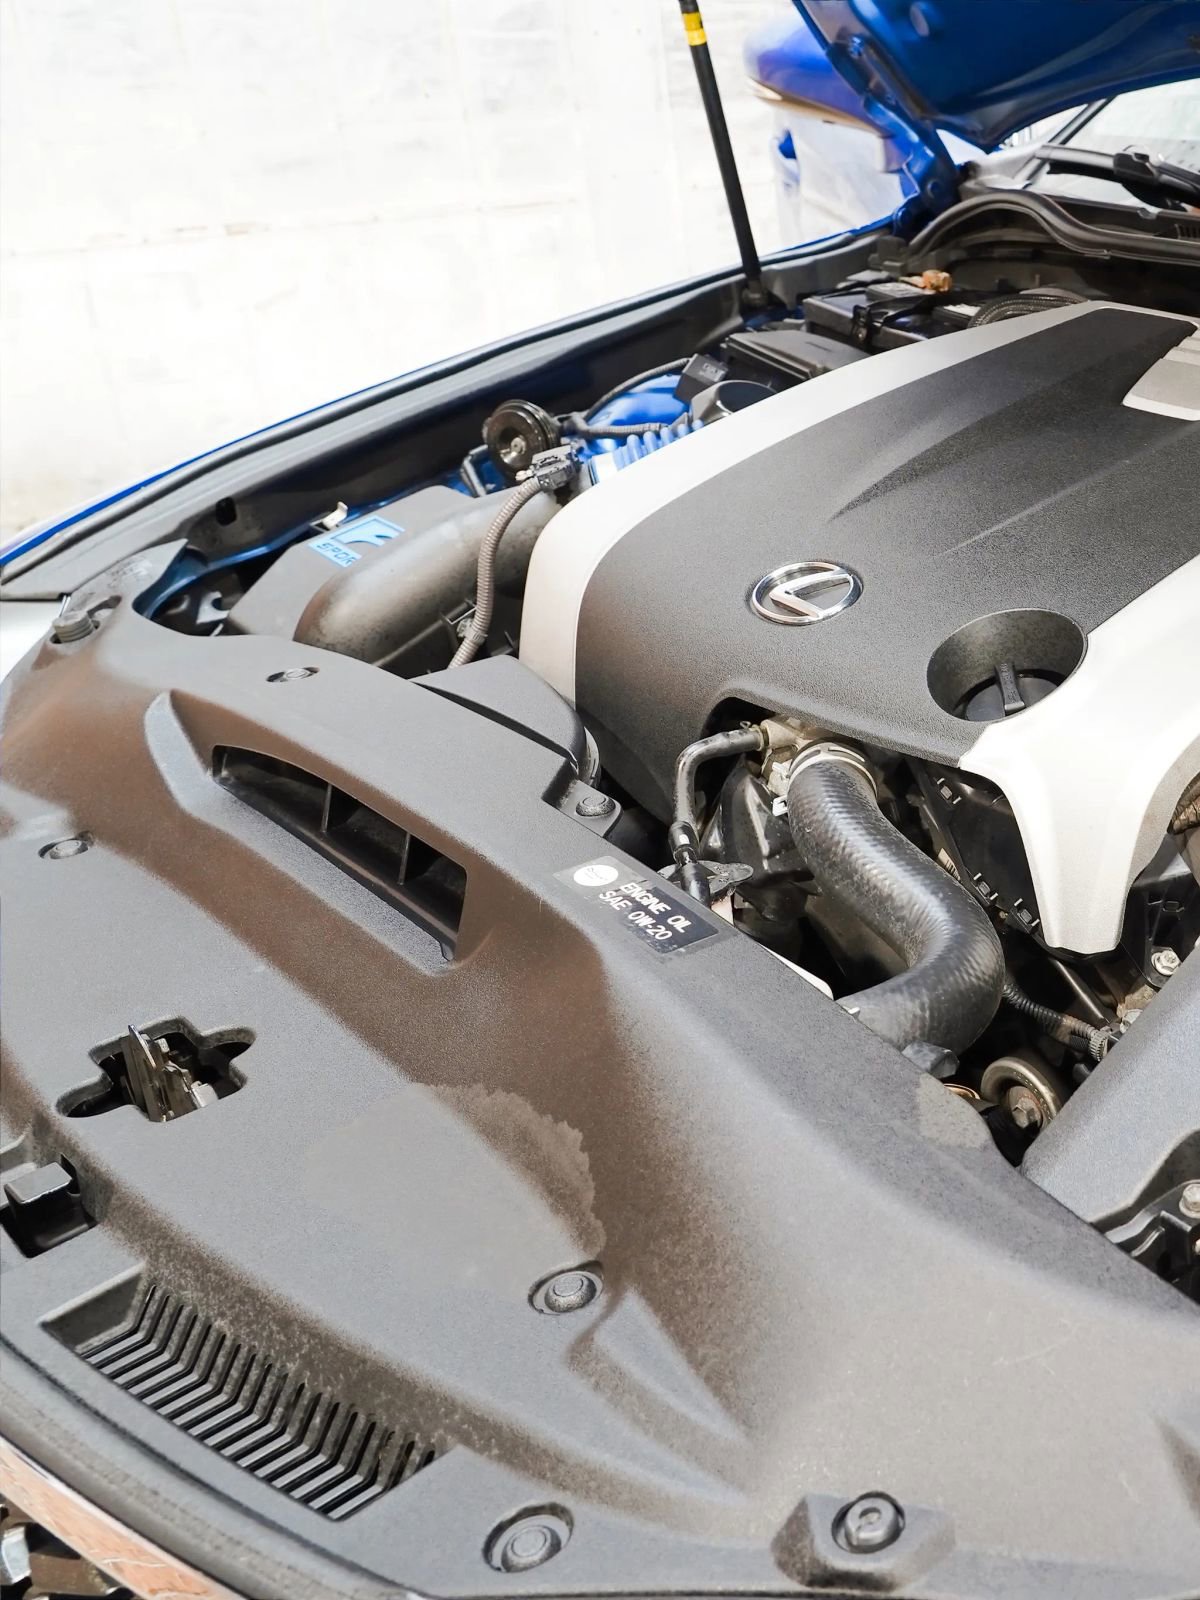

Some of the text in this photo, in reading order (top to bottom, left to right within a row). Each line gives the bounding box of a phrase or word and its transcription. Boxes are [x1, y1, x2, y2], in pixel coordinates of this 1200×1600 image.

[599, 890, 673, 941] SAE 0W-20
[619, 881, 694, 934] ENGINE OIL
